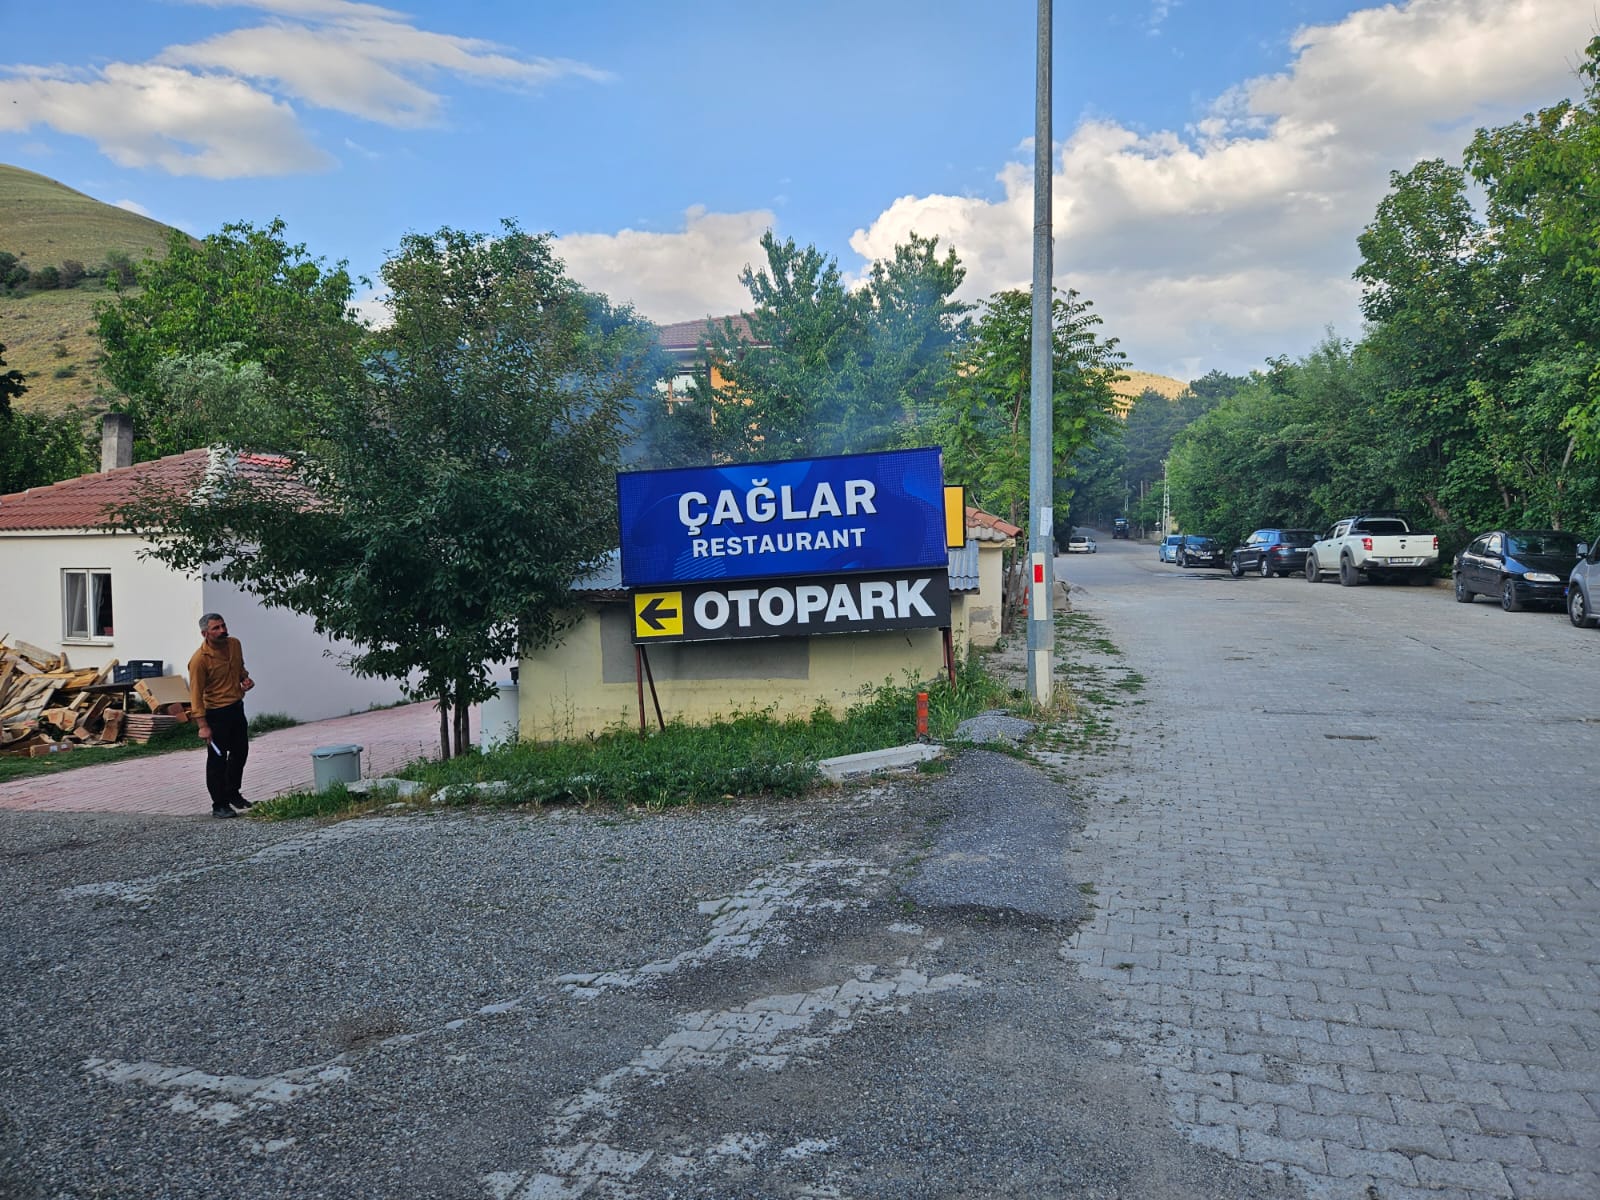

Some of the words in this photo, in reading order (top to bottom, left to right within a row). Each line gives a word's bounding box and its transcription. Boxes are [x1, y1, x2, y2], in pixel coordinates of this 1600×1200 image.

[678, 478, 877, 536] ÇAĞLAR
[692, 527, 866, 558] RESTAURANT
[693, 578, 936, 630] OTOPARK
